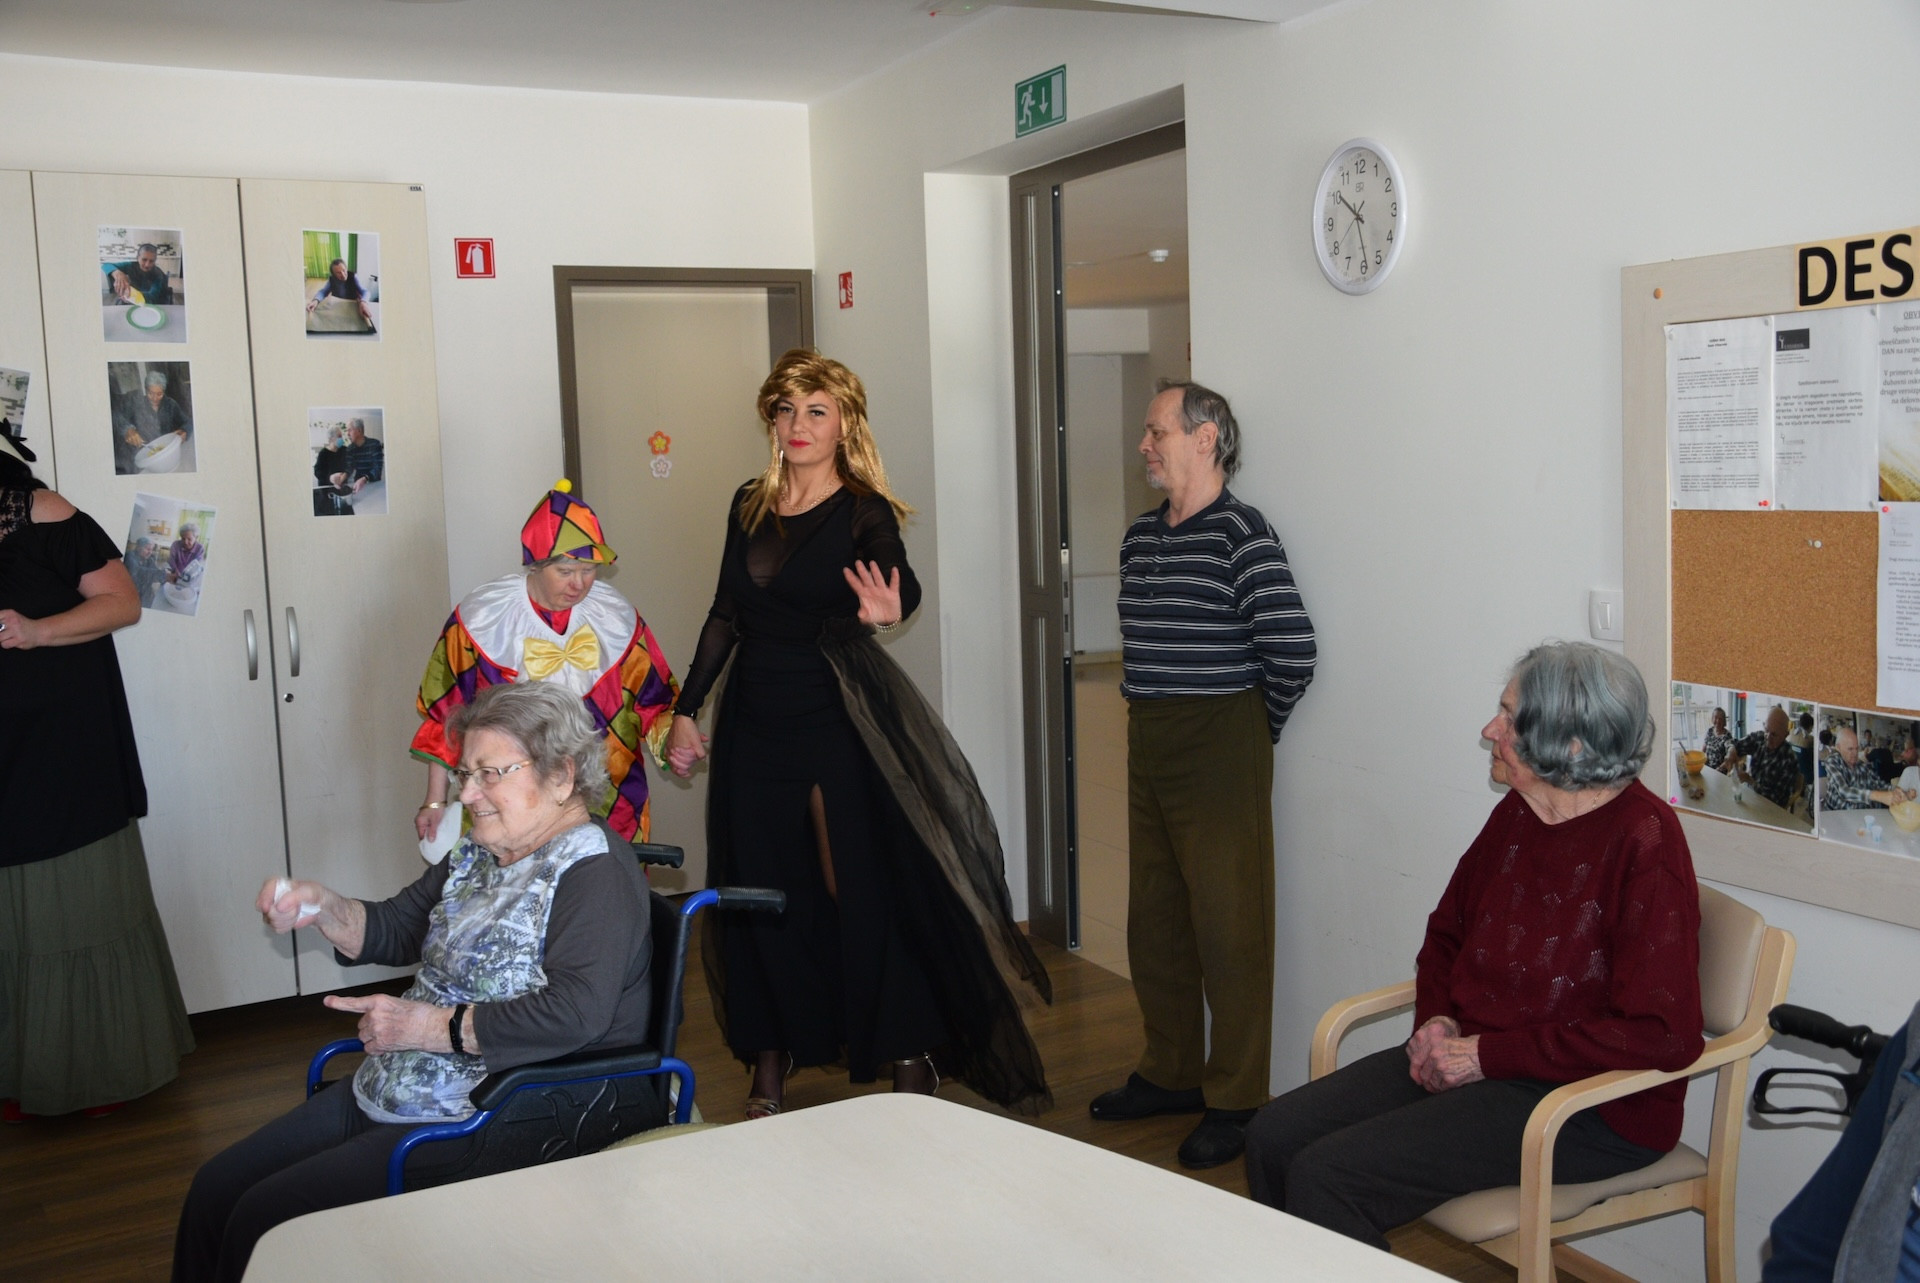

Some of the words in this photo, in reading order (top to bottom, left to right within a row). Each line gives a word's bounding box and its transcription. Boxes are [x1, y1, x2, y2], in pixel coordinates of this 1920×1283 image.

[1354, 158, 1366, 175] 12
[1373, 162, 1378, 178] 1
[1340, 170, 1350, 186] 11
[1384, 177, 1392, 193] 2
[1331, 190, 1341, 206] 10
[1390, 202, 1397, 217] 3
[1327, 217, 1334, 232] 9
[1386, 229, 1394, 244] 4
[1333, 240, 1340, 256] 8
[1344, 256, 1352, 271] 7
[1375, 249, 1382, 265] 5
[1360, 259, 1368, 275] 6
[1799, 233, 1914, 306] DES
